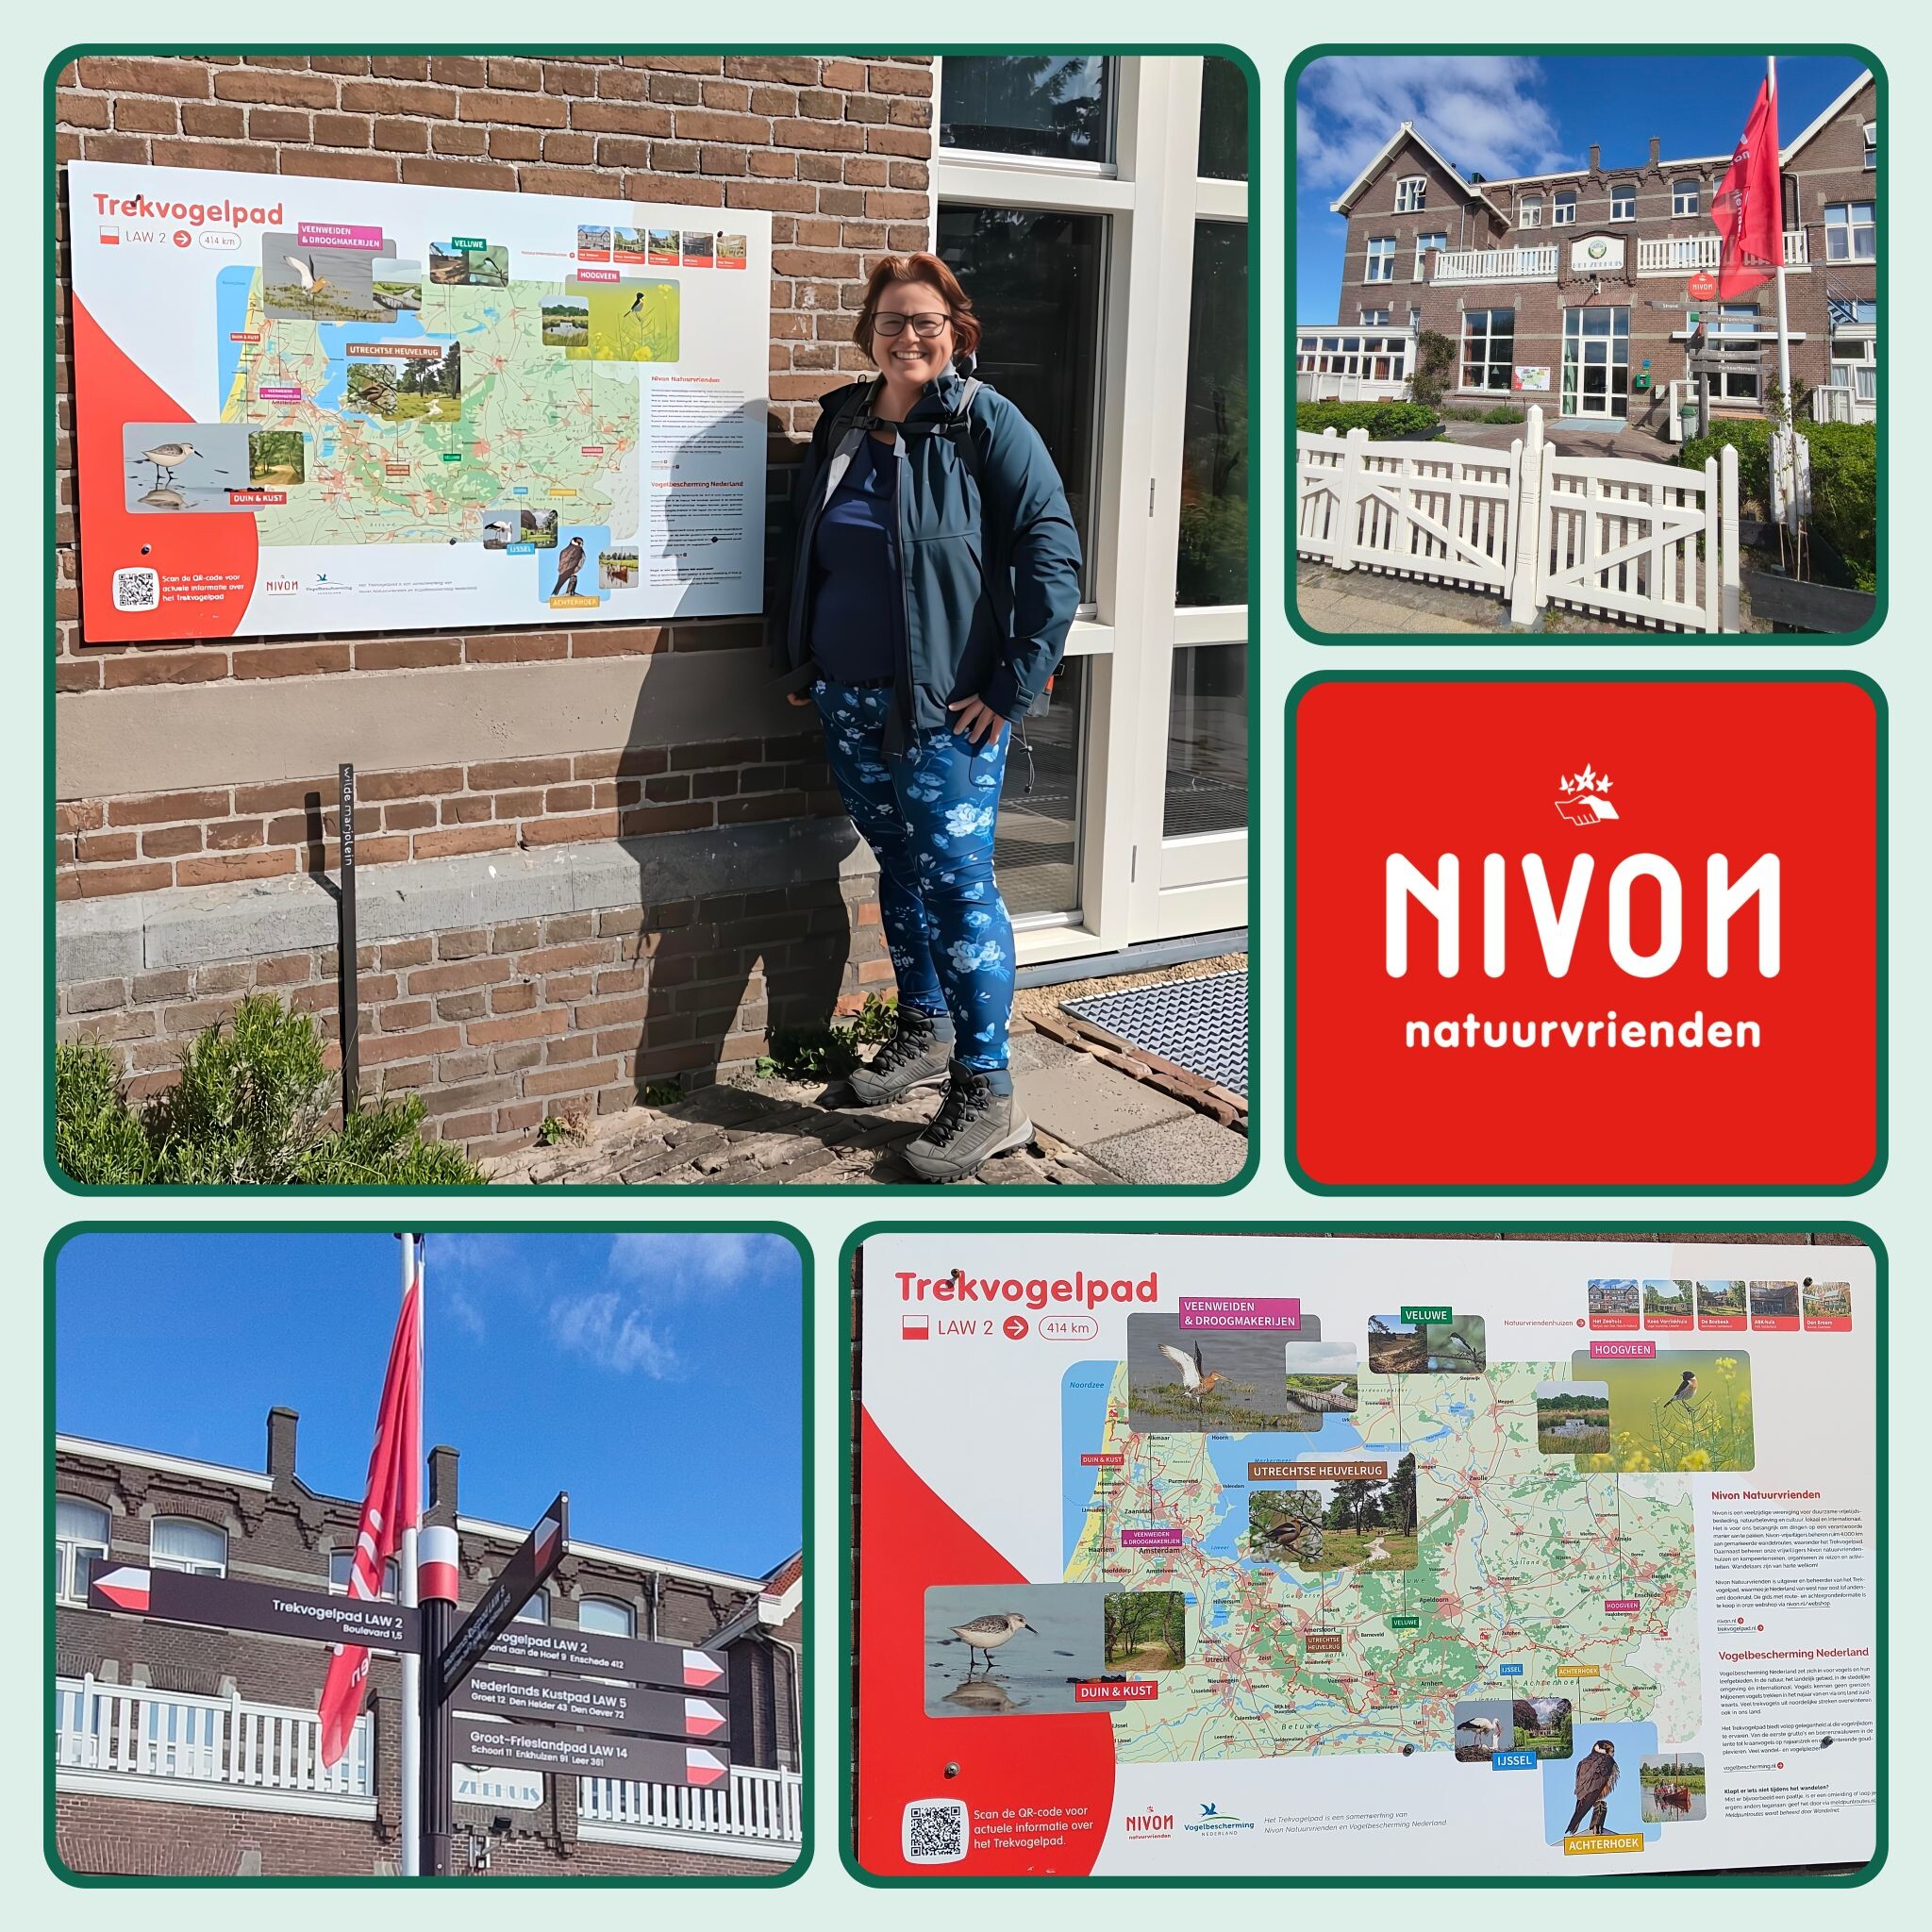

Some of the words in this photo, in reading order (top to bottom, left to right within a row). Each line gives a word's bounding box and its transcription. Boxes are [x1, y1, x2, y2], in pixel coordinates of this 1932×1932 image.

[93, 193, 283, 227] Trekvogelpad
[302, 225, 351, 235] VEENWEIDEN
[125, 230, 154, 243] LAW
[158, 232, 166, 243] 2
[205, 236, 219, 244] 414
[223, 236, 235, 245] km
[310, 237, 379, 247] DROOGMAKERIJEN
[455, 240, 483, 248] VELUWE
[580, 272, 617, 281] HOOGVEEN
[349, 345, 392, 355] UTRECHTSE
[394, 347, 438, 357] HEUVELRUG
[651, 480, 709, 489] Vogelbescherming
[162, 575, 179, 583] Scan
[266, 581, 298, 592] NIVON
[344, 767, 353, 801] wilde
[342, 806, 354, 866] marjolein
[895, 1270, 1158, 1309] Trekvogelpad
[1185, 1302, 1255, 1311] VEENWEIDEN
[1185, 1317, 1192, 1325] &
[1195, 1317, 1295, 1326] DROOGMAKERIJEN
[1406, 1311, 1447, 1320] VELUWE
[938, 1321, 975, 1335] LAW
[983, 1321, 992, 1334] 2
[1047, 1323, 1068, 1333] 414
[1072, 1323, 1089, 1334] km
[1254, 1467, 1316, 1476] UTRECHTSE
[1320, 1467, 1382, 1475] HEUVELRUG
[1712, 1491, 1740, 1500] Nivon
[1743, 1491, 1821, 1499] Natuurvrienden
[273, 1599, 361, 1624] Trekvogelpad
[365, 1612, 392, 1626] LAW
[394, 1617, 404, 1628] 2
[342, 1624, 389, 1639] Boulevard
[391, 1630, 403, 1641] 1,5
[496, 1632, 551, 1650] vogelpad
[554, 1639, 578, 1652] LAW
[580, 1641, 588, 1653] 2
[509, 1647, 525, 1656] aan
[527, 1647, 539, 1657] de
[541, 1649, 558, 1659] Hoef
[570, 1655, 608, 1666] Enschede
[611, 1659, 624, 1669] 412
[1719, 1650, 1814, 1662] Vogelbescherming
[1817, 1648, 1869, 1657] Nederland
[471, 1678, 539, 1697] Nederlands
[542, 1688, 590, 1705] Kustpad
[592, 1695, 618, 1707] LAW
[620, 1697, 626, 1708] 5
[1081, 1688, 1109, 1697] DUIN
[1112, 1687, 1120, 1696] &
[1124, 1686, 1152, 1695] KUST
[472, 1692, 494, 1703] Groet
[509, 1697, 525, 1706] Den
[527, 1699, 555, 1709] Helder
[558, 1703, 567, 1711] 43
[571, 1704, 587, 1714] Den
[589, 1706, 613, 1718] Oever
[615, 1709, 625, 1719] 72
[470, 1730, 587, 1755] Groot-Frieslandpad
[590, 1744, 614, 1757] LAW
[616, 1747, 627, 1758] 14
[471, 1744, 504, 1757] Schoorl
[506, 1748, 512, 1757] 11
[516, 1750, 558, 1762] Enkhuizen
[560, 1754, 568, 1763] 91
[572, 1755, 589, 1765] Leer
[591, 1757, 604, 1767] 361
[1497, 1756, 1532, 1766] IJSSEL
[974, 1810, 998, 1820] Scan
[1002, 1808, 1015, 1818] de
[1019, 1807, 1062, 1818] QR-code
[1065, 1807, 1088, 1816] voor
[1278, 1815, 1324, 1824] Trekvogelpad
[974, 1824, 1012, 1834] actuele
[1016, 1823, 1068, 1833] informatie
[1126, 1815, 1174, 1831] NIVON
[1185, 1823, 1254, 1831] Vogelbescherming
[1286, 1824, 1338, 1833] Natuurvrienden
[1349, 1821, 1410, 1830] Vogelbescherming
[974, 1839, 991, 1848] het
[993, 1836, 1066, 1848] Trekvogelpad.
[1569, 1838, 1639, 1851] ACHTERHOEK
